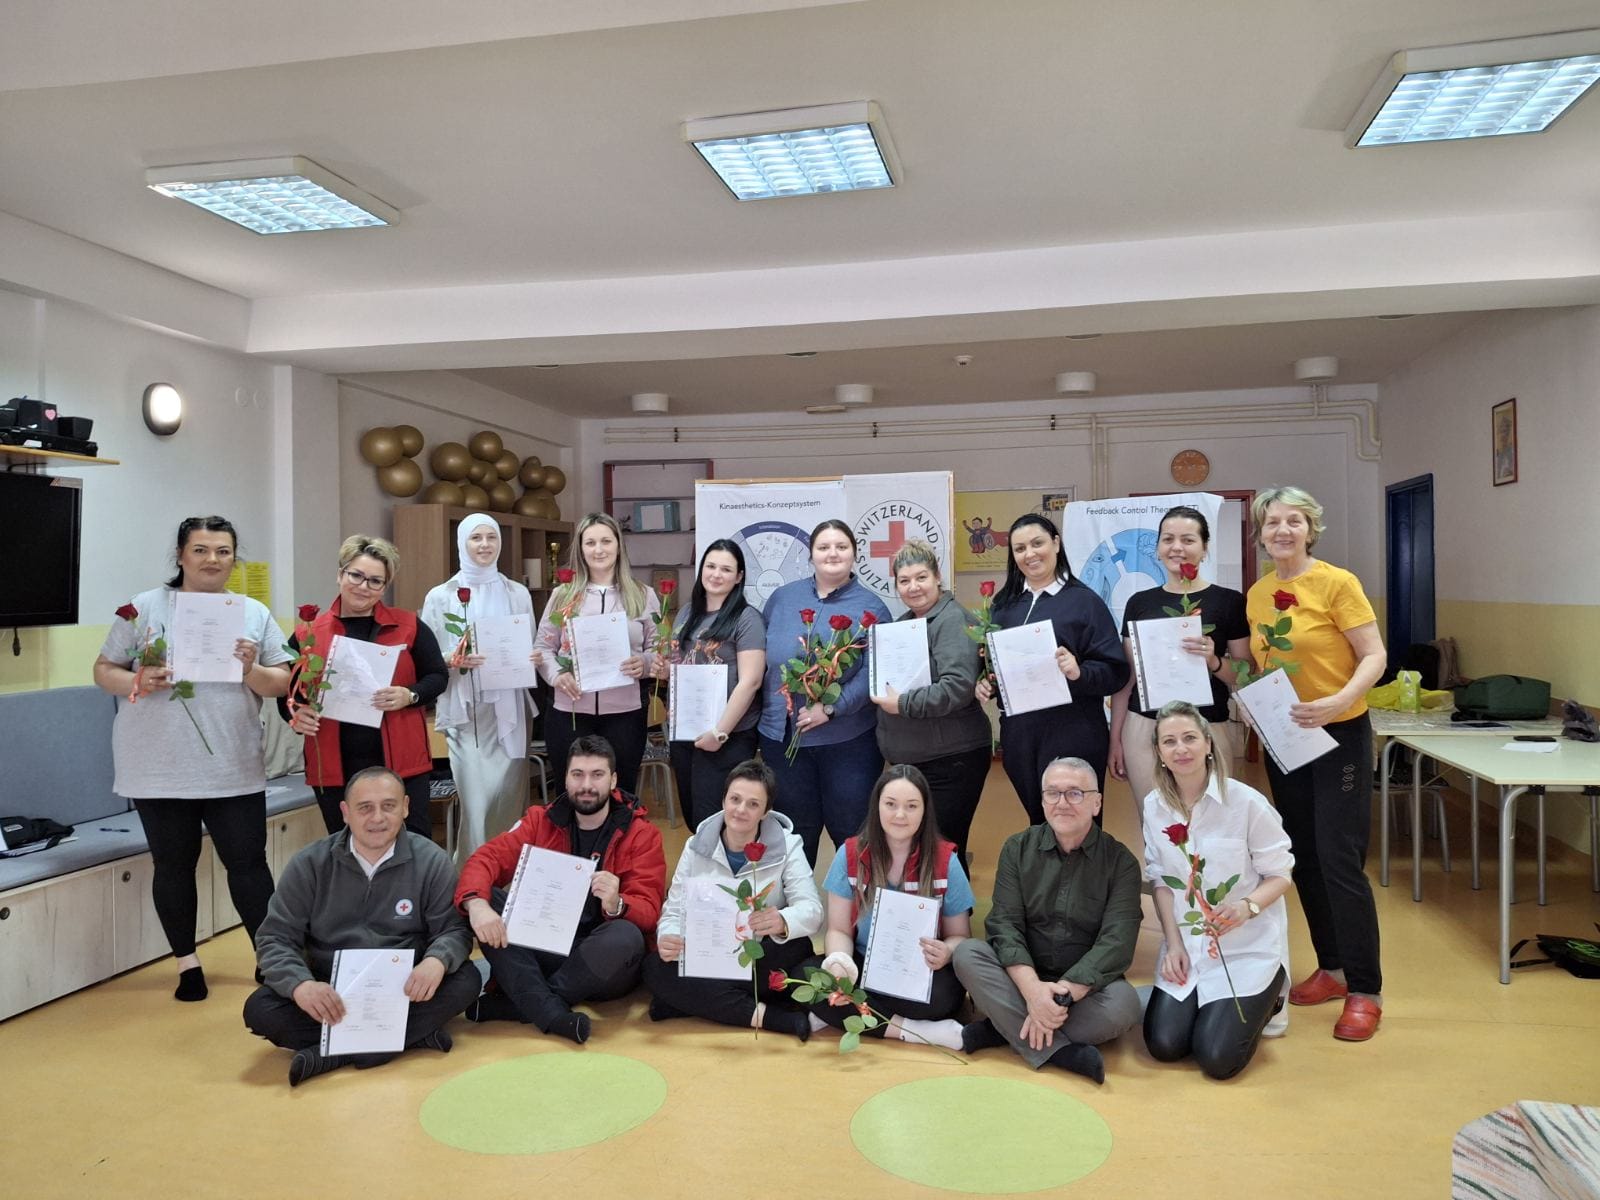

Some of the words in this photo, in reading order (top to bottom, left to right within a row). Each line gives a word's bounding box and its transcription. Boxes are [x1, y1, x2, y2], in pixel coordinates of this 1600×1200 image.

[719, 500, 821, 510] Kinaesthetics-Konzeptsystem
[1086, 506, 1119, 515] Feedback
[1121, 505, 1148, 514] Control
[1150, 505, 1169, 514] Theo
[856, 505, 939, 546] SWITZERLAND
